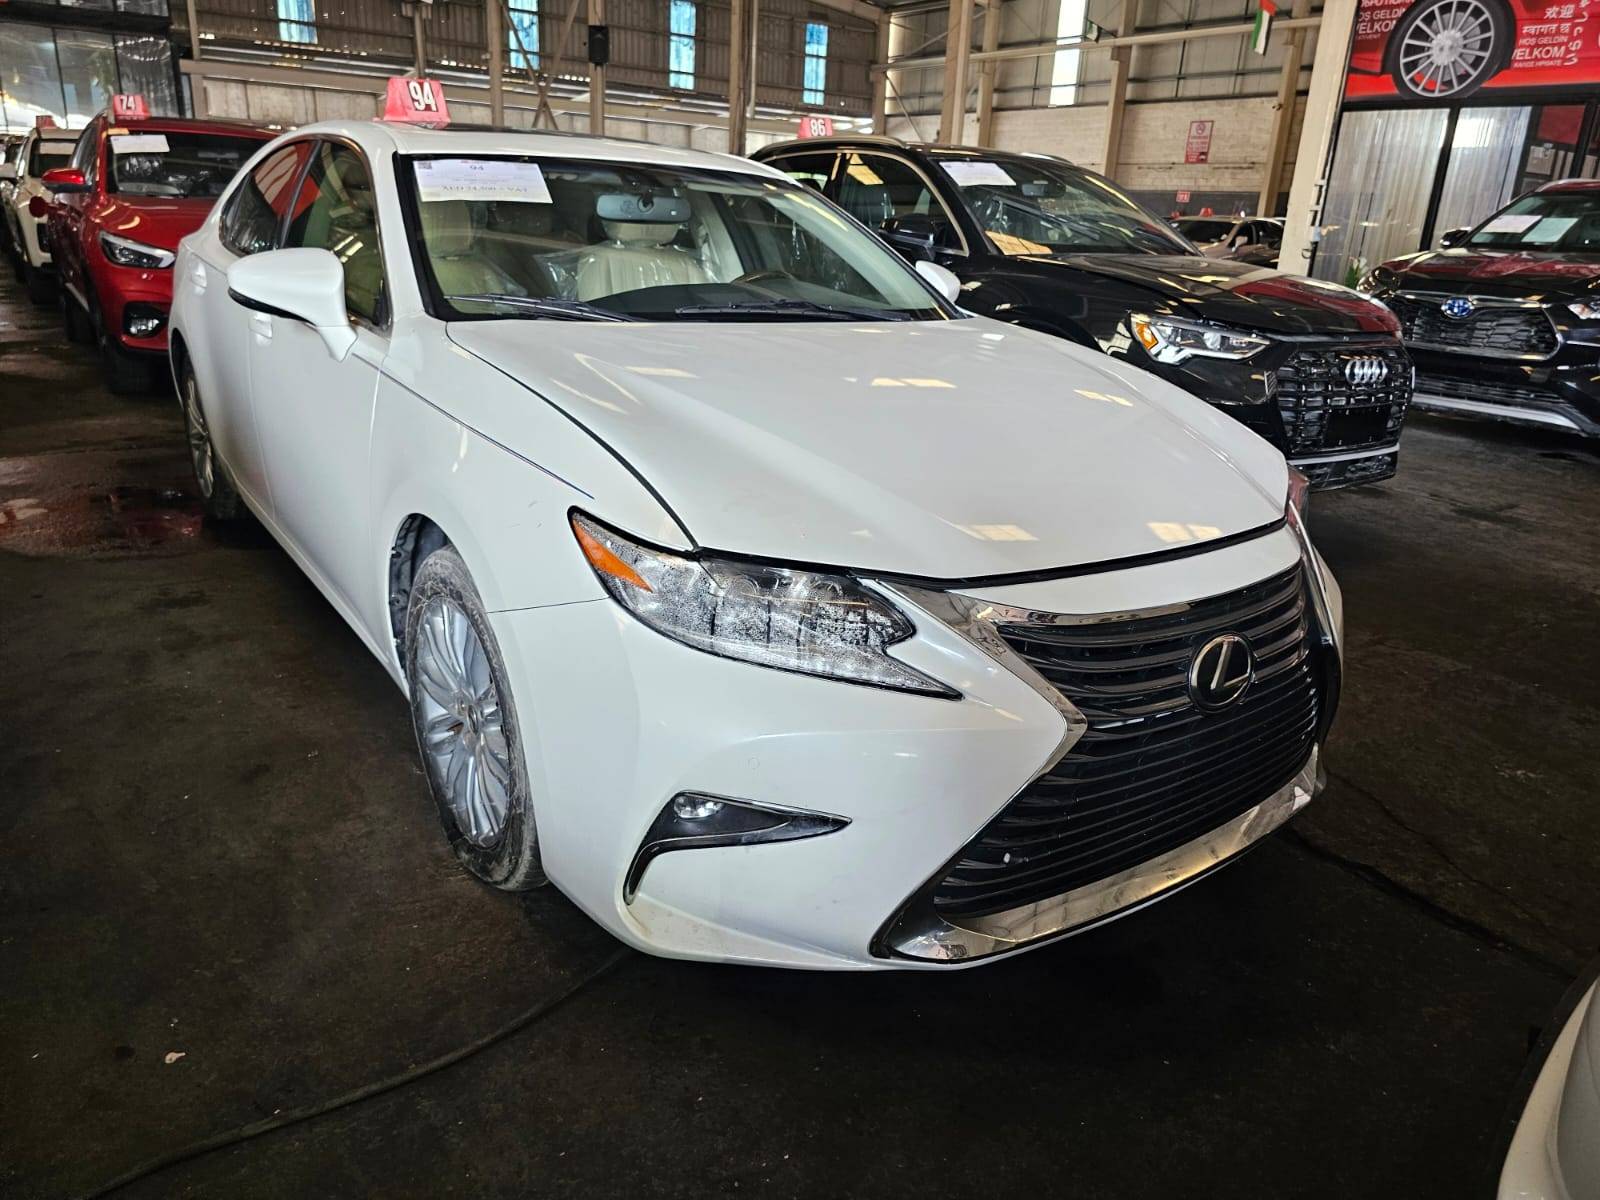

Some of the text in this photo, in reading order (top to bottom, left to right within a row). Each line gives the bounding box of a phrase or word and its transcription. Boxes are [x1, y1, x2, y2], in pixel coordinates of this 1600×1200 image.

[1544, 4, 1575, 19] 欢迎
[1356, 20, 1396, 34] ELKO
[120, 95, 136, 112] 74
[408, 79, 438, 112] 94
[810, 118, 826, 137] 86
